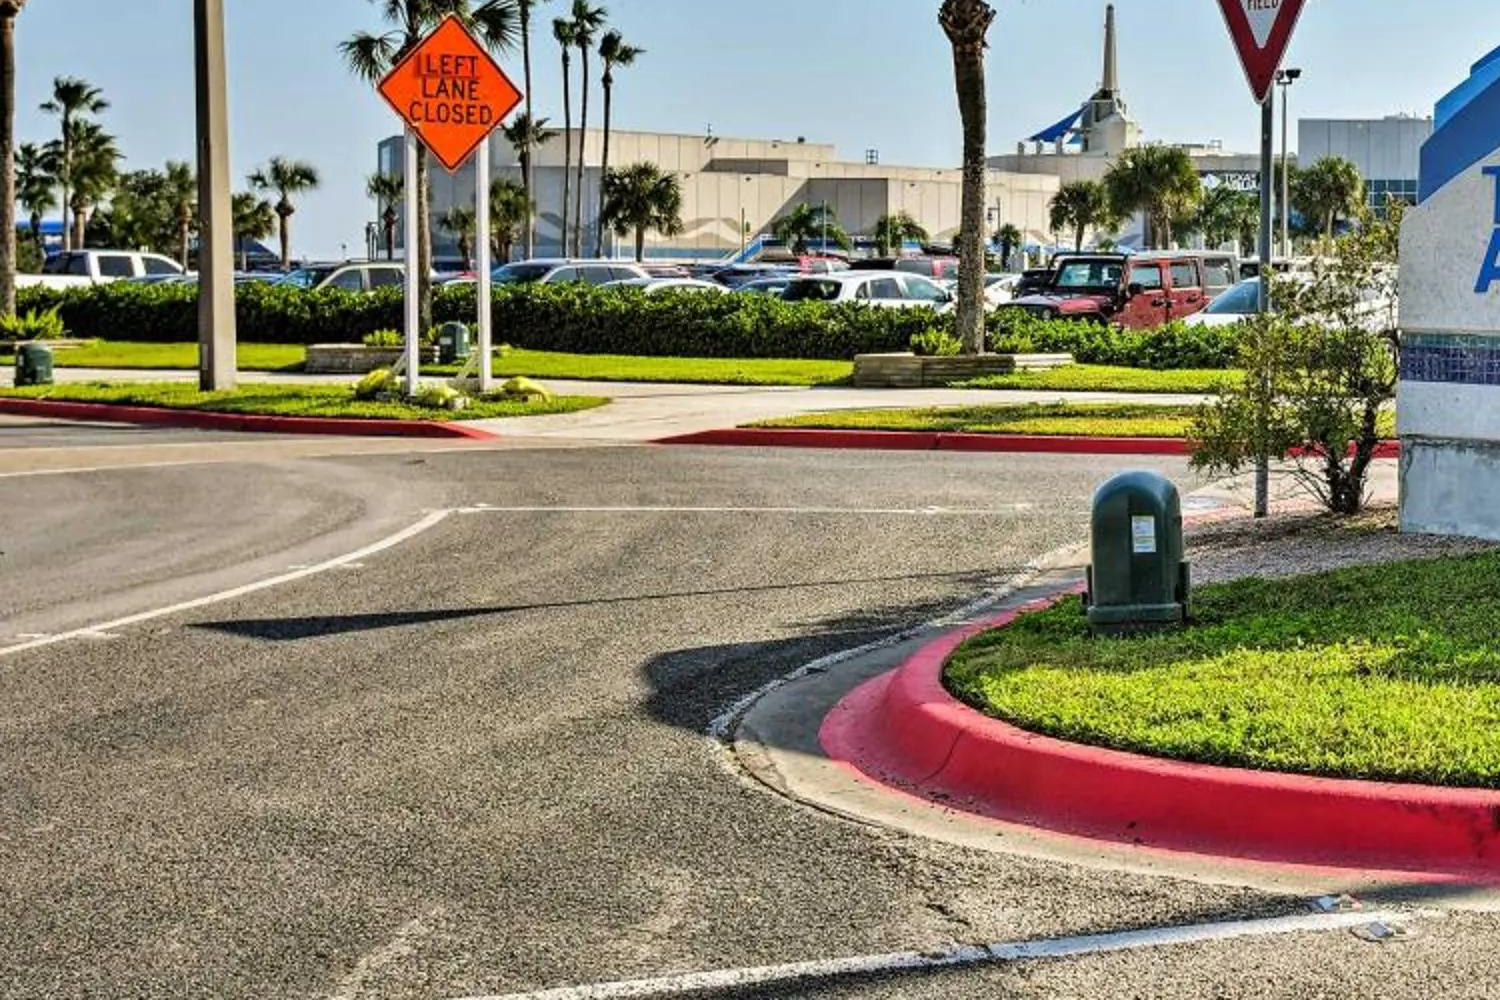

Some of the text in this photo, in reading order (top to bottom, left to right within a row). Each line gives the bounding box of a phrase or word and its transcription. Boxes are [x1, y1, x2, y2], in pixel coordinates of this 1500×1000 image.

[427, 53, 478, 77] LEFT
[423, 76, 480, 101] LANE
[409, 100, 493, 125] CLOSED
